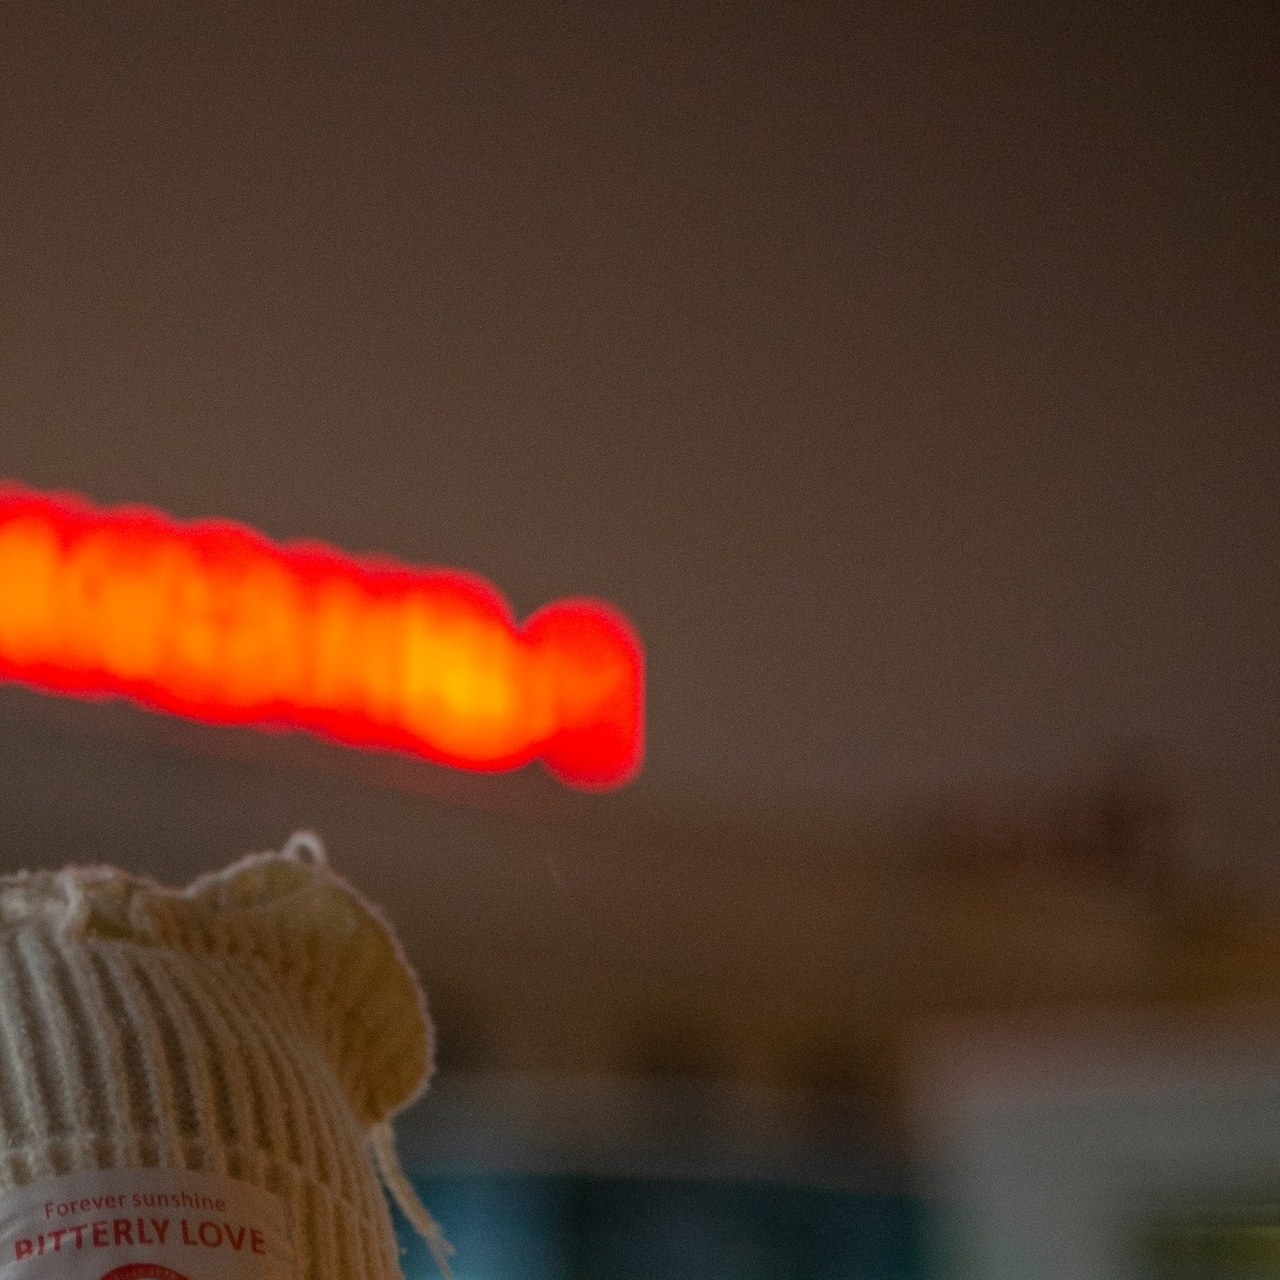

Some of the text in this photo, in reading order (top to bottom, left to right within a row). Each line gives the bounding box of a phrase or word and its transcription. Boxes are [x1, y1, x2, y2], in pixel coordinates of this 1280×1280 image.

[44, 1190, 226, 1218] Forever sunshine
[181, 1219, 266, 1255] LOVE
